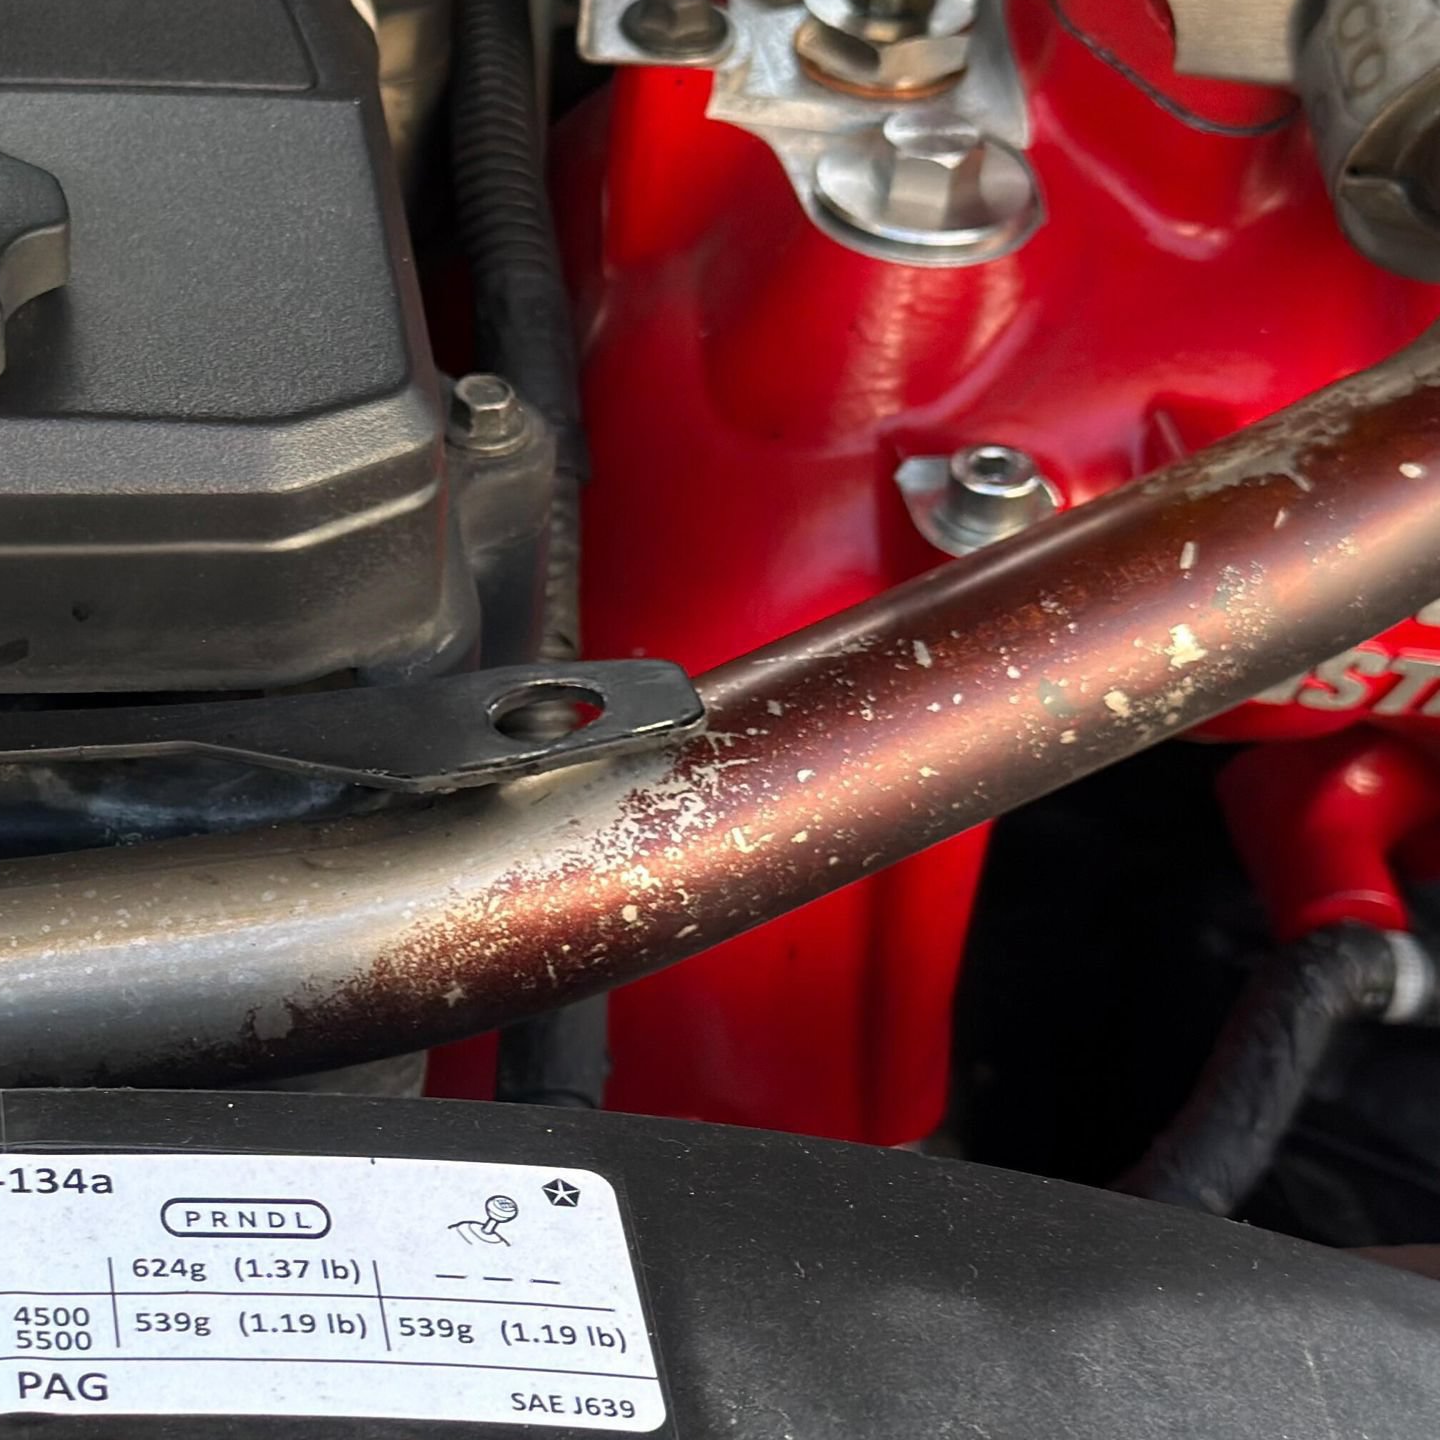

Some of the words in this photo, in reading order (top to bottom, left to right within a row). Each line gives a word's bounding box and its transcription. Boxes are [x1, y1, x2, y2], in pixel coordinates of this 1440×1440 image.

[132, 1257, 208, 1283] 624g
[234, 1256, 310, 1283] (1.37
[321, 1258, 361, 1285] lb)
[13, 1306, 91, 1328] 4500
[134, 1312, 212, 1337] 539g
[239, 1311, 317, 1337] (1.19
[327, 1312, 368, 1340] lb)
[15, 1330, 93, 1351] 5500
[398, 1317, 475, 1344] 539g
[501, 1319, 577, 1347] (1.19
[586, 1325, 627, 1354] lb)
[18, 1371, 109, 1402] PAG
[511, 1392, 566, 1414] SAE
[573, 1395, 636, 1419] J639
